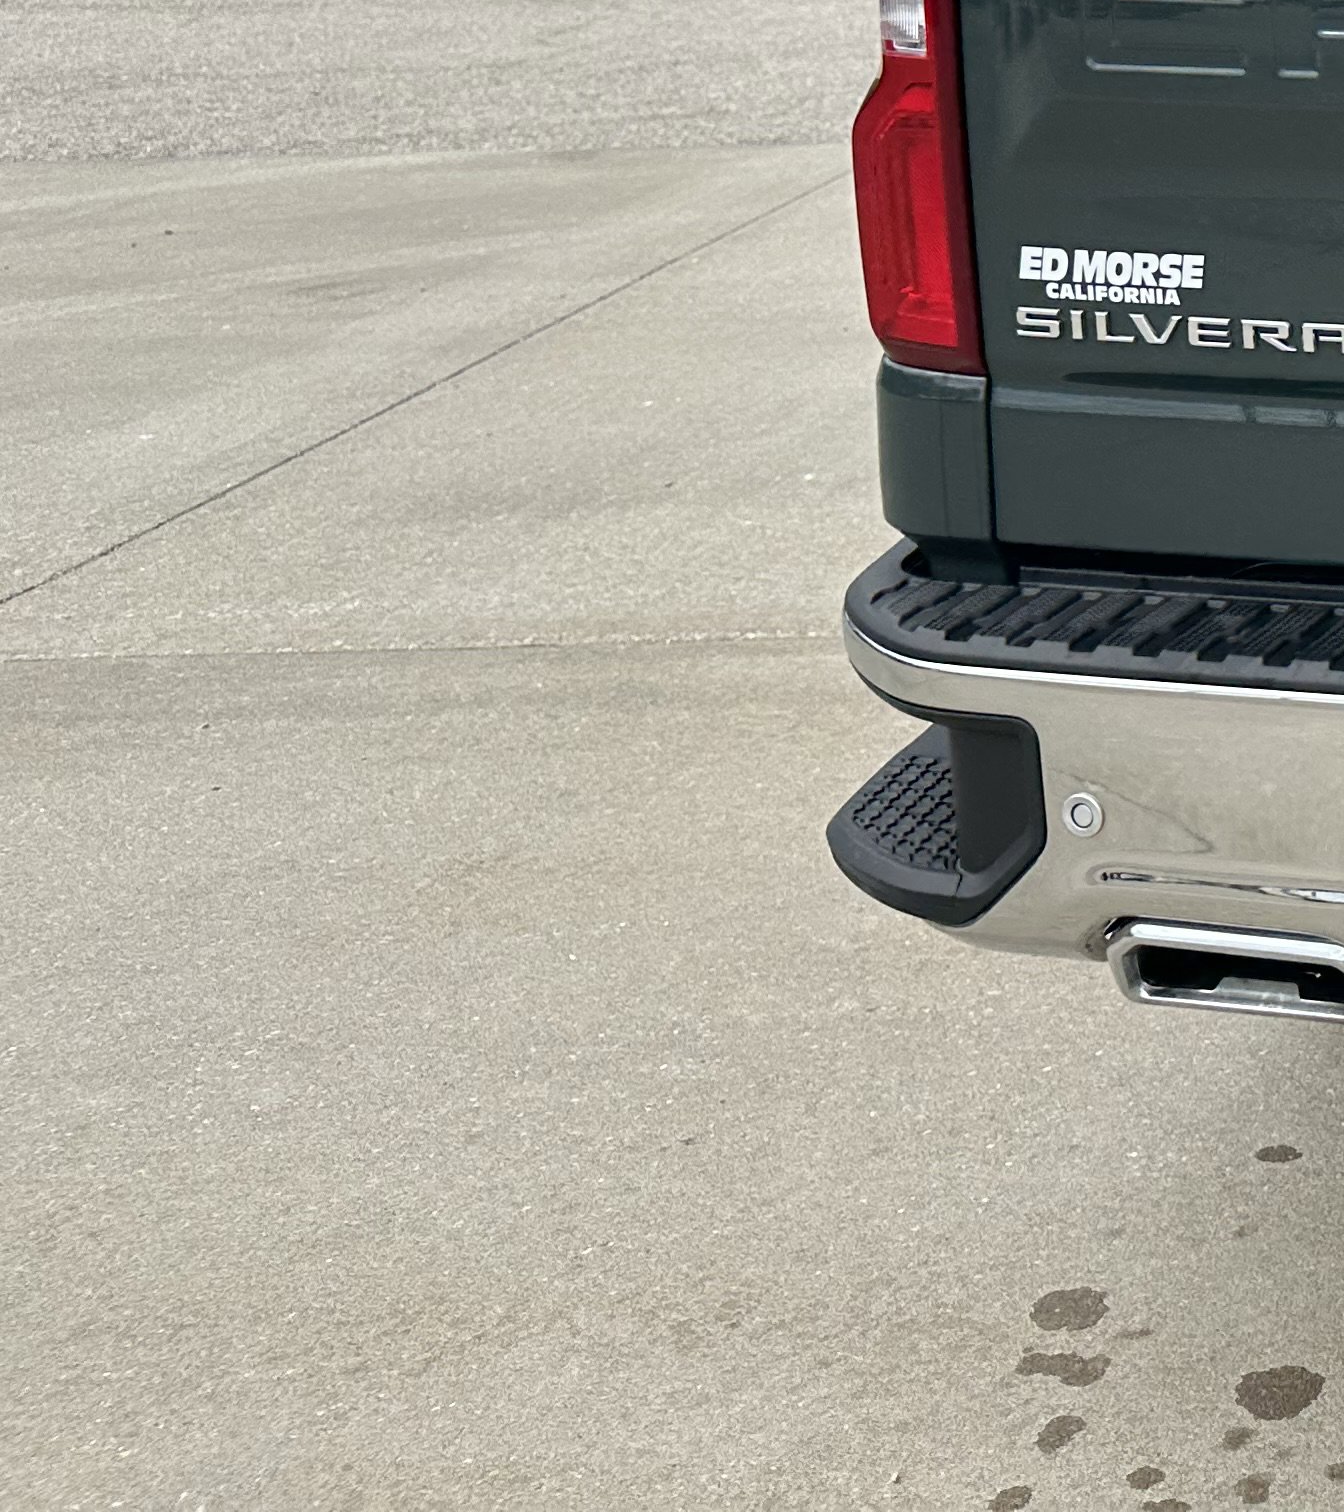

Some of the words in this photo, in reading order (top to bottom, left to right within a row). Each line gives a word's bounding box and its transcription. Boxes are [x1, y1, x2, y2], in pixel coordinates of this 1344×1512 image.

[1018, 244, 1069, 282] ED
[1073, 249, 1206, 290] MORSE
[1045, 281, 1182, 306] CALIFORNIA
